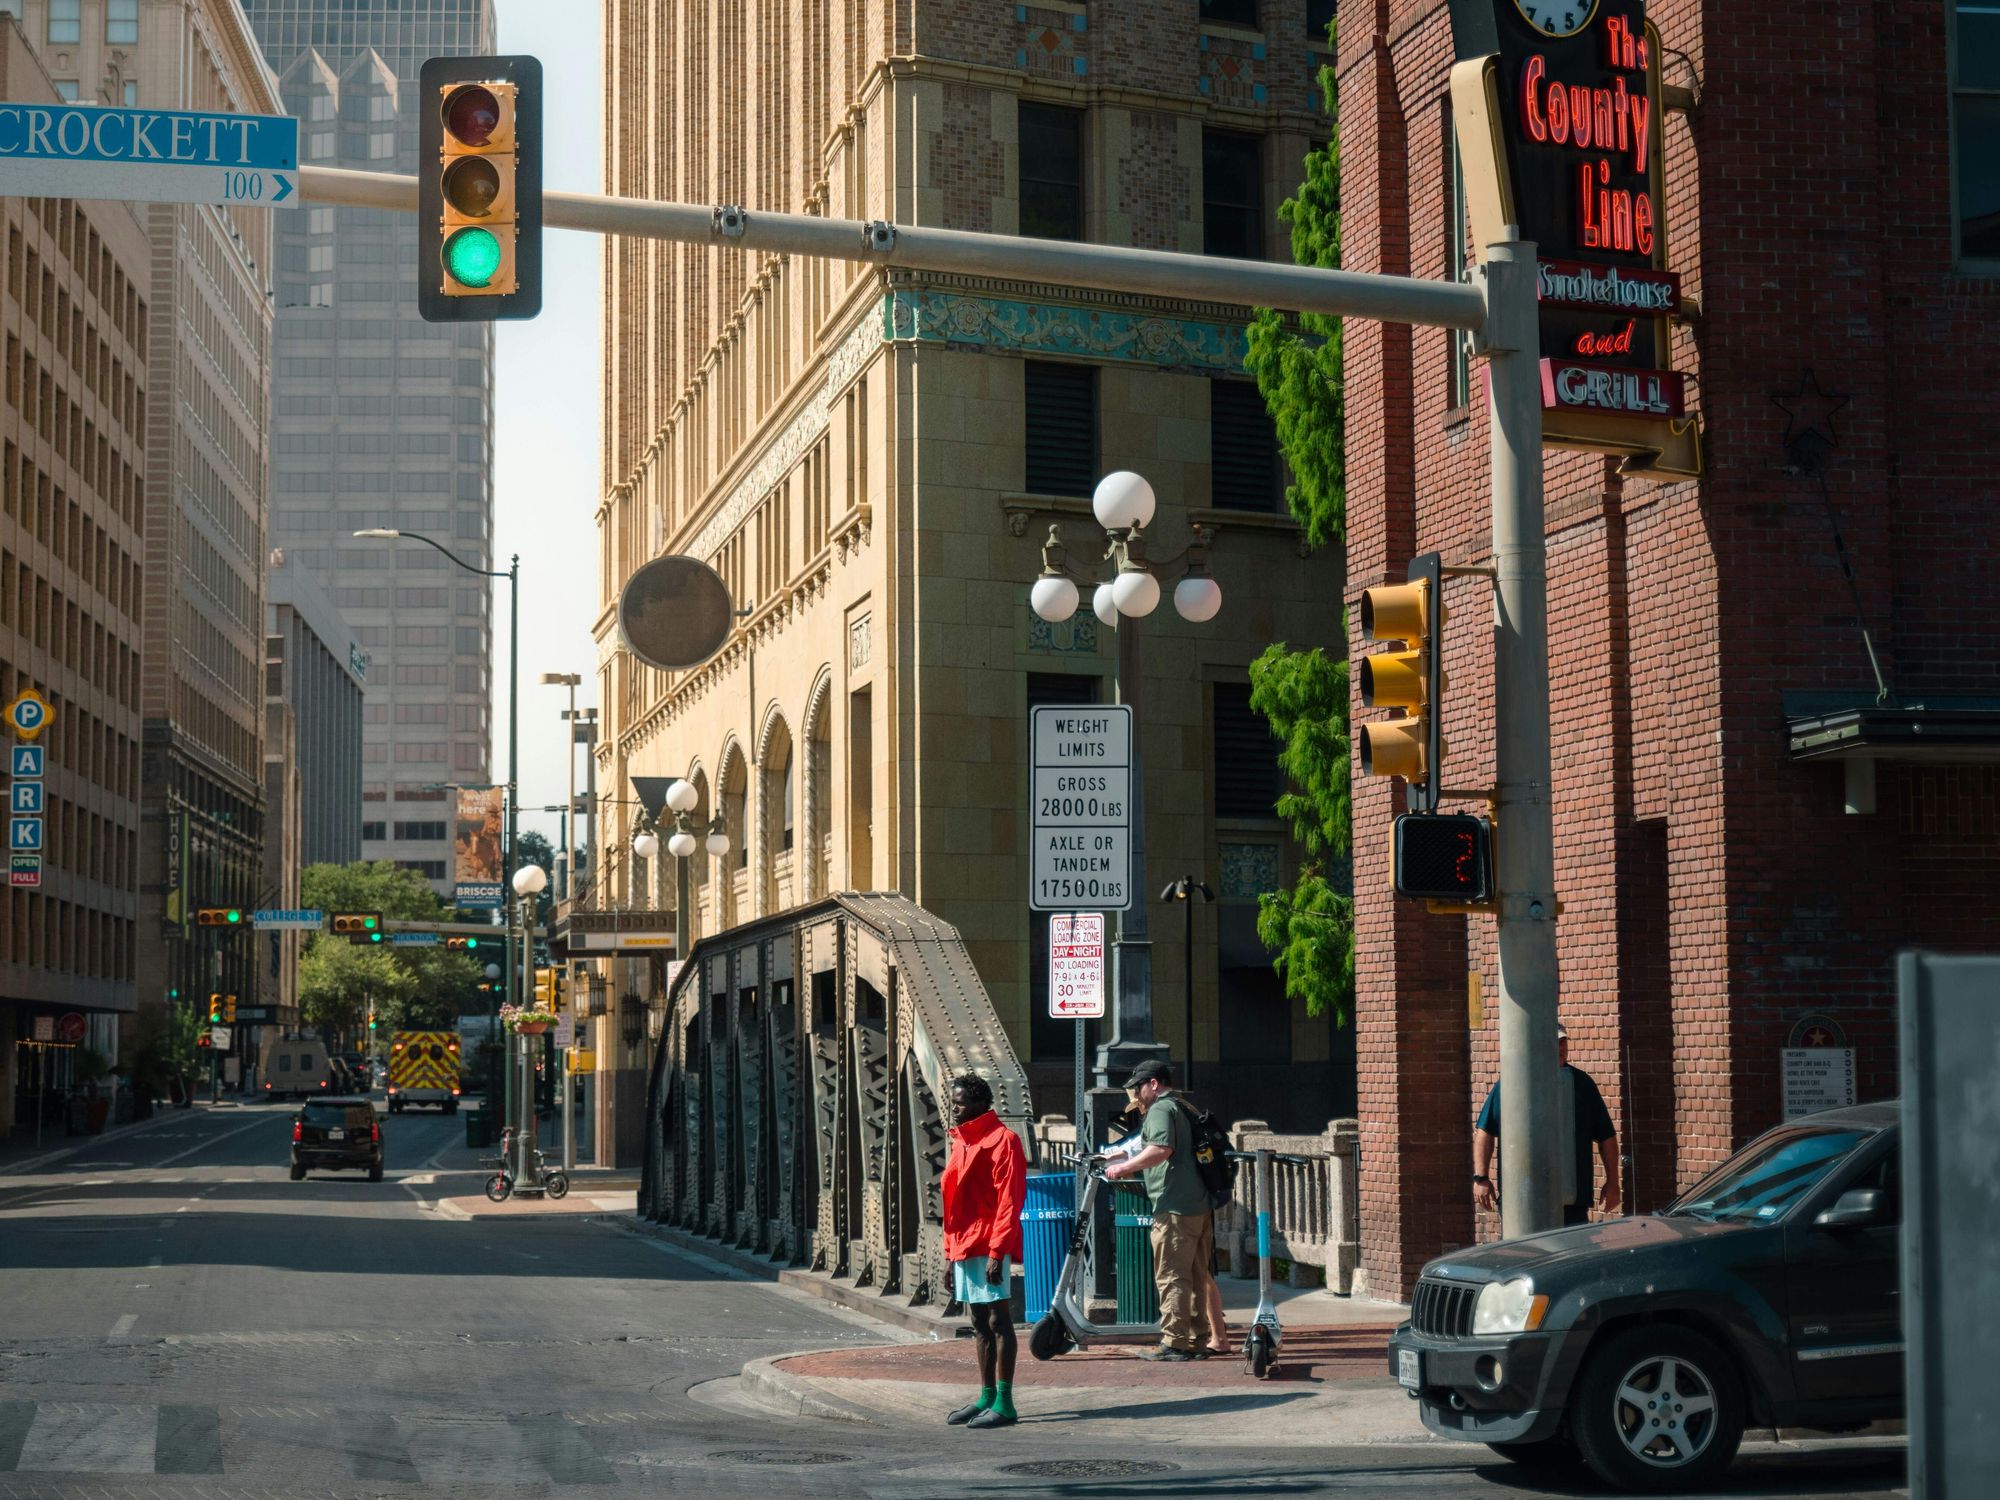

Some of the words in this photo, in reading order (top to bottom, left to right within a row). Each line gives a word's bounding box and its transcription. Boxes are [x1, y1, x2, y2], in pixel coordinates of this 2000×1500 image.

[1544, 17, 1555, 32] 6
[1565, 12, 1575, 29] 5
[1607, 13, 1649, 71] The
[1523, 54, 1650, 175] County
[0, 108, 259, 164] CROCKETT
[223, 171, 263, 201] 100
[1582, 158, 1654, 256] Line
[1539, 263, 1675, 309] Smokehouse
[1575, 318, 1636, 357] and
[1556, 366, 1671, 414] GRILL
[1055, 719, 1109, 734] WEIGHT
[1058, 743, 1105, 757] LIMITS
[1057, 777, 1106, 792] GROSS
[458, 804, 487, 815] here
[1041, 798, 1098, 817] 28000
[1102, 803, 1122, 817] LBS
[1049, 837, 1085, 851] AXLE
[1094, 836, 1113, 851] OR
[169, 817, 179, 888] HOME
[13, 859, 38, 867] OPEN
[1052, 857, 1110, 872] TANDEM
[13, 872, 36, 882] FULL
[456, 887, 502, 896] BRISCOE
[1041, 879, 1099, 898] 17500
[1102, 883, 1122, 897] LBS
[256, 911, 302, 921] COLLEGE
[307, 911, 318, 921] ST
[1056, 920, 1097, 932] COMMERCIAL
[1054, 932, 1081, 943] LOADING
[1083, 931, 1100, 942] ZONE
[1053, 946, 1102, 957] DAY-NIGHT
[1054, 960, 1065, 970] NO
[1068, 960, 1100, 969] LOADING
[1057, 984, 1074, 996] 30
